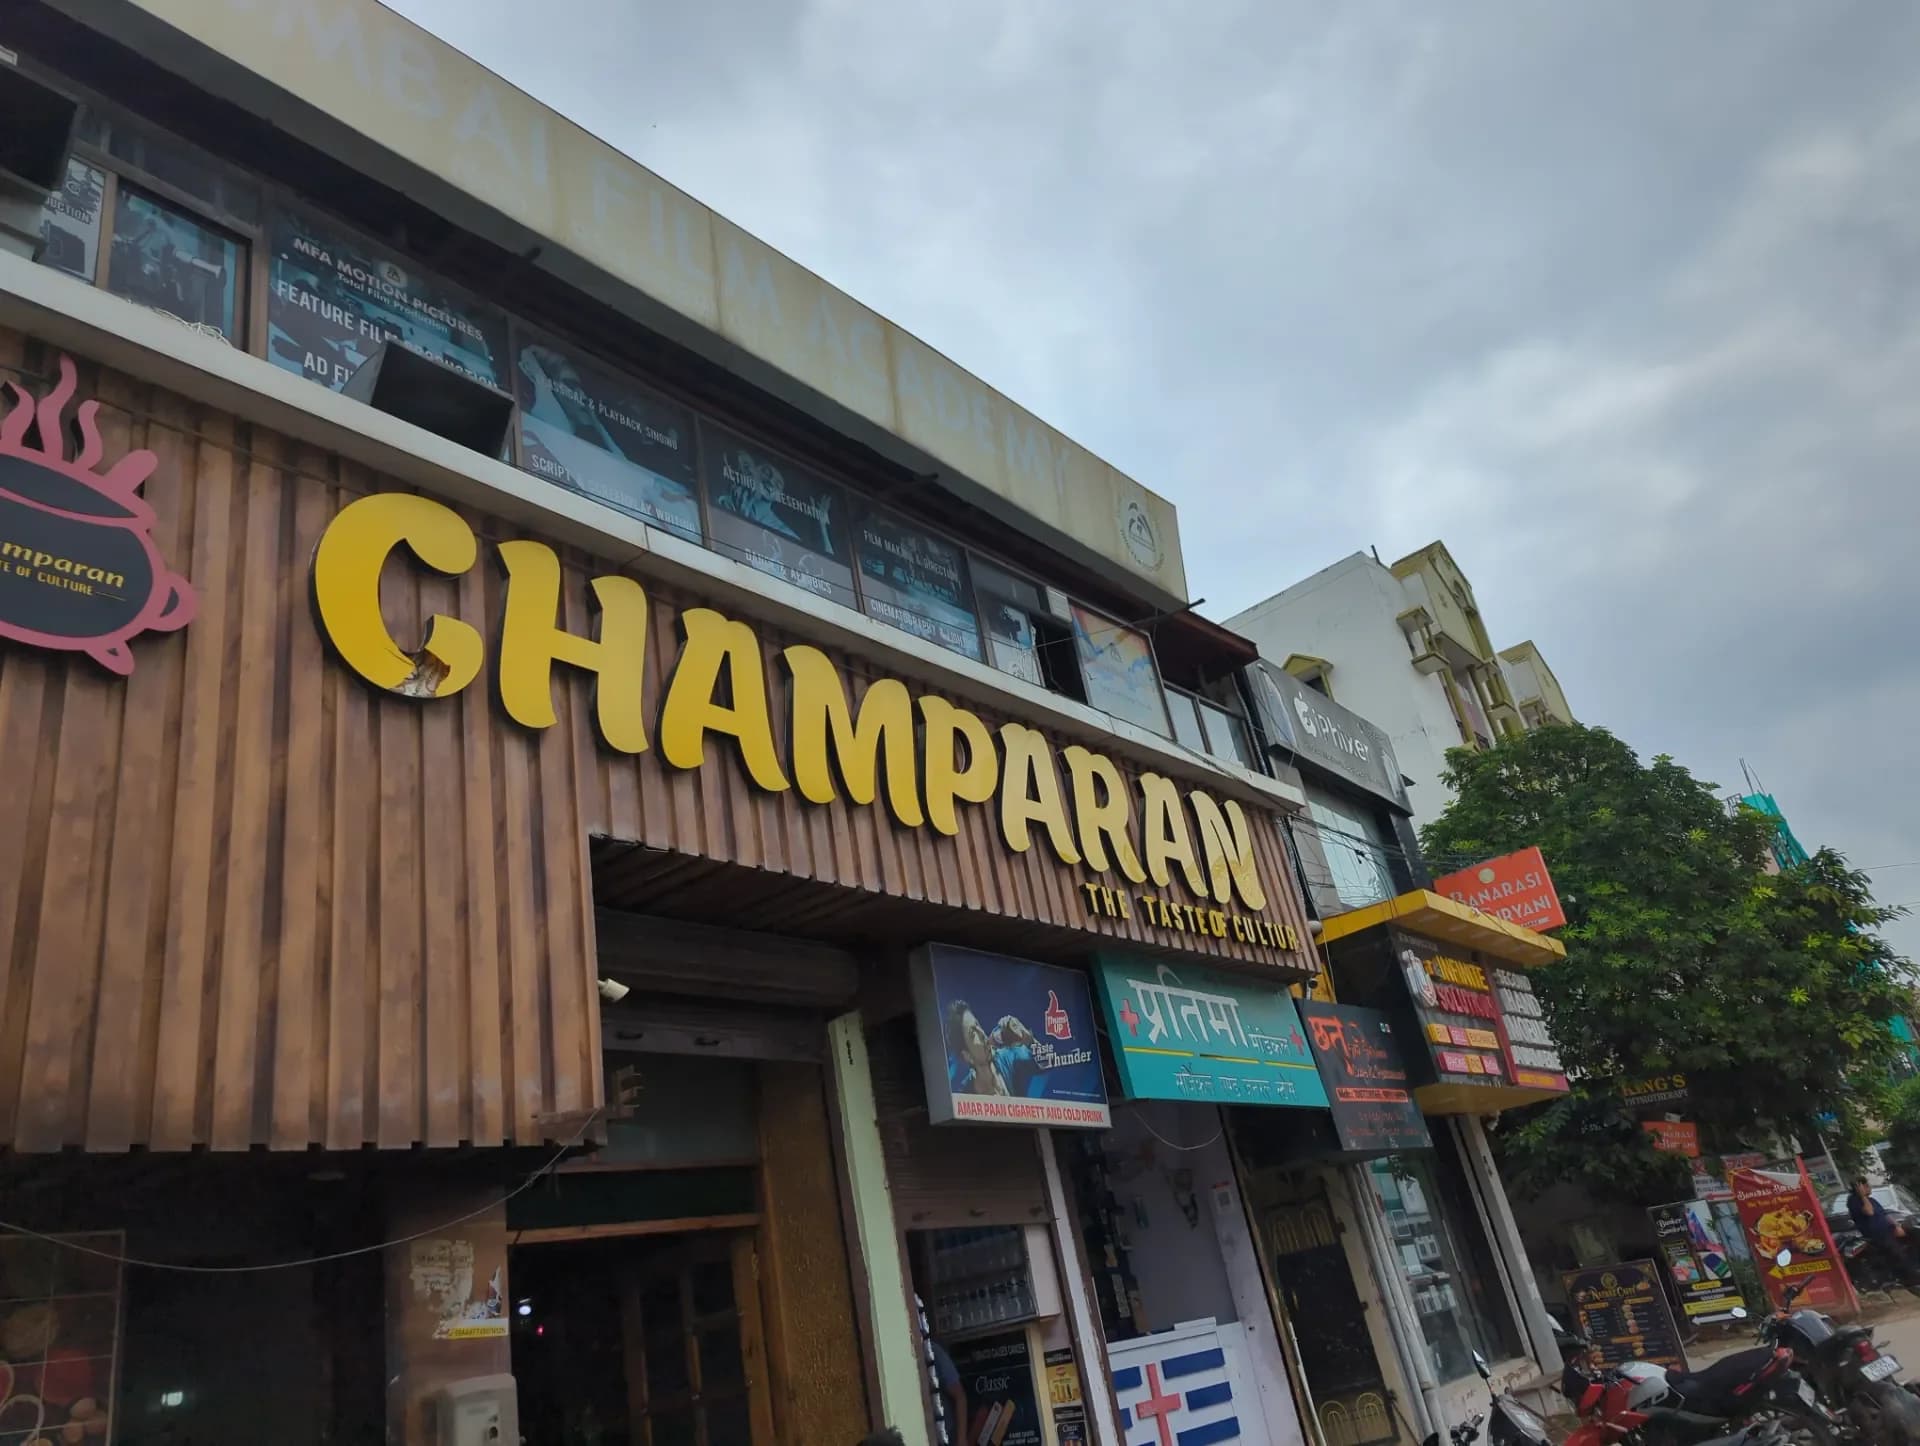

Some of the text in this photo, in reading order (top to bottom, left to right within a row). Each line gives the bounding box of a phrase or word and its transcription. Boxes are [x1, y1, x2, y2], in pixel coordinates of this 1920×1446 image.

[293, 238, 484, 341] MFA MOTION PICTURES
[337, 271, 364, 292] Total
[368, 286, 391, 305] Film
[277, 279, 354, 331] FEATURE
[303, 351, 328, 376] AD
[598, 403, 642, 434] PLAYBACK
[532, 454, 573, 482] SCRIPT
[16, 564, 32, 579] OF
[38, 571, 94, 596] CULTURE
[313, 492, 1267, 912] CHAMPARAN
[1450, 872, 1542, 906] BANARASI
[1085, 883, 1130, 920] THE
[1143, 896, 1209, 936] TASTE
[1125, 963, 1249, 1047] प्रतिमा
[1030, 1042, 1054, 1057] Taste
[1046, 1048, 1092, 1068] Thunder
[957, 1102, 1104, 1124] AMAR PAAN CIGARETT AND COLD DRINK
[975, 1375, 1011, 1395] Classic
